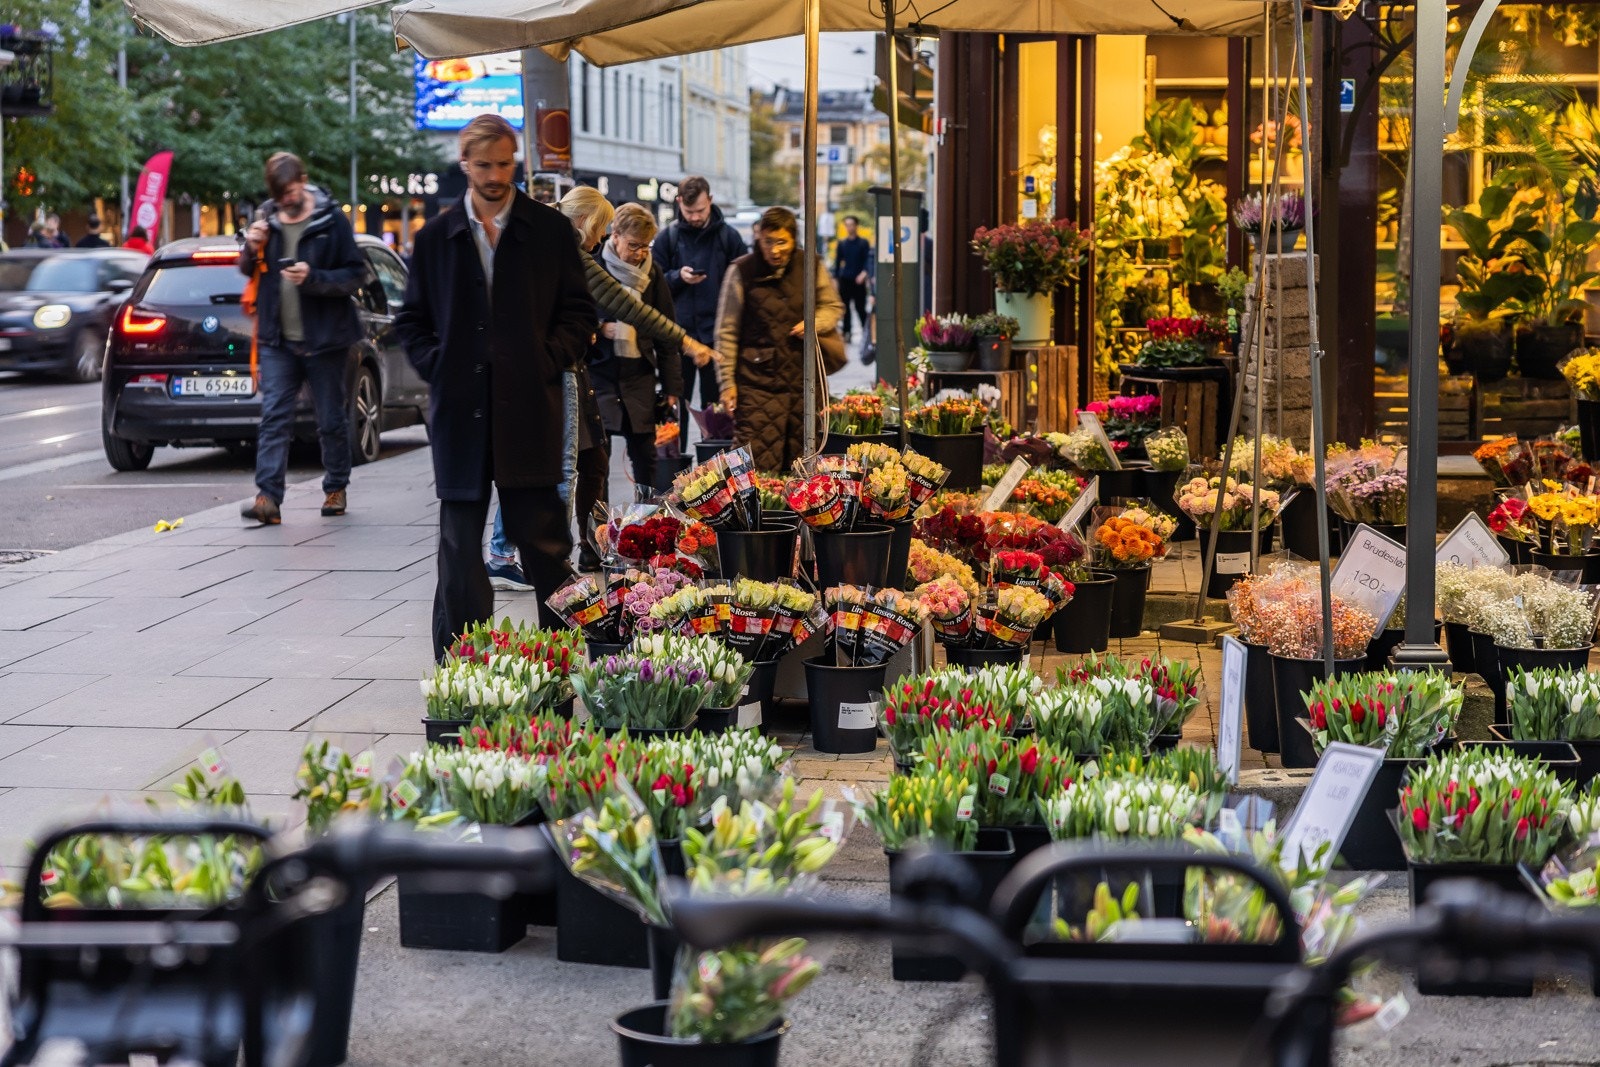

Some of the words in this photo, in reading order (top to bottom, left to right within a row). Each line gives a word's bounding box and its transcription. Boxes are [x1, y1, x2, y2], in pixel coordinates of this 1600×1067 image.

[366, 173, 439, 195] ICKS
[185, 379, 199, 392] EL
[205, 379, 248, 392] 65946
[701, 486, 720, 502] Roses
[1362, 539, 1406, 569] Brudeslør
[735, 607, 757, 617] Roses
[872, 606, 896, 620] Linssen
[895, 615, 915, 631] Roses
